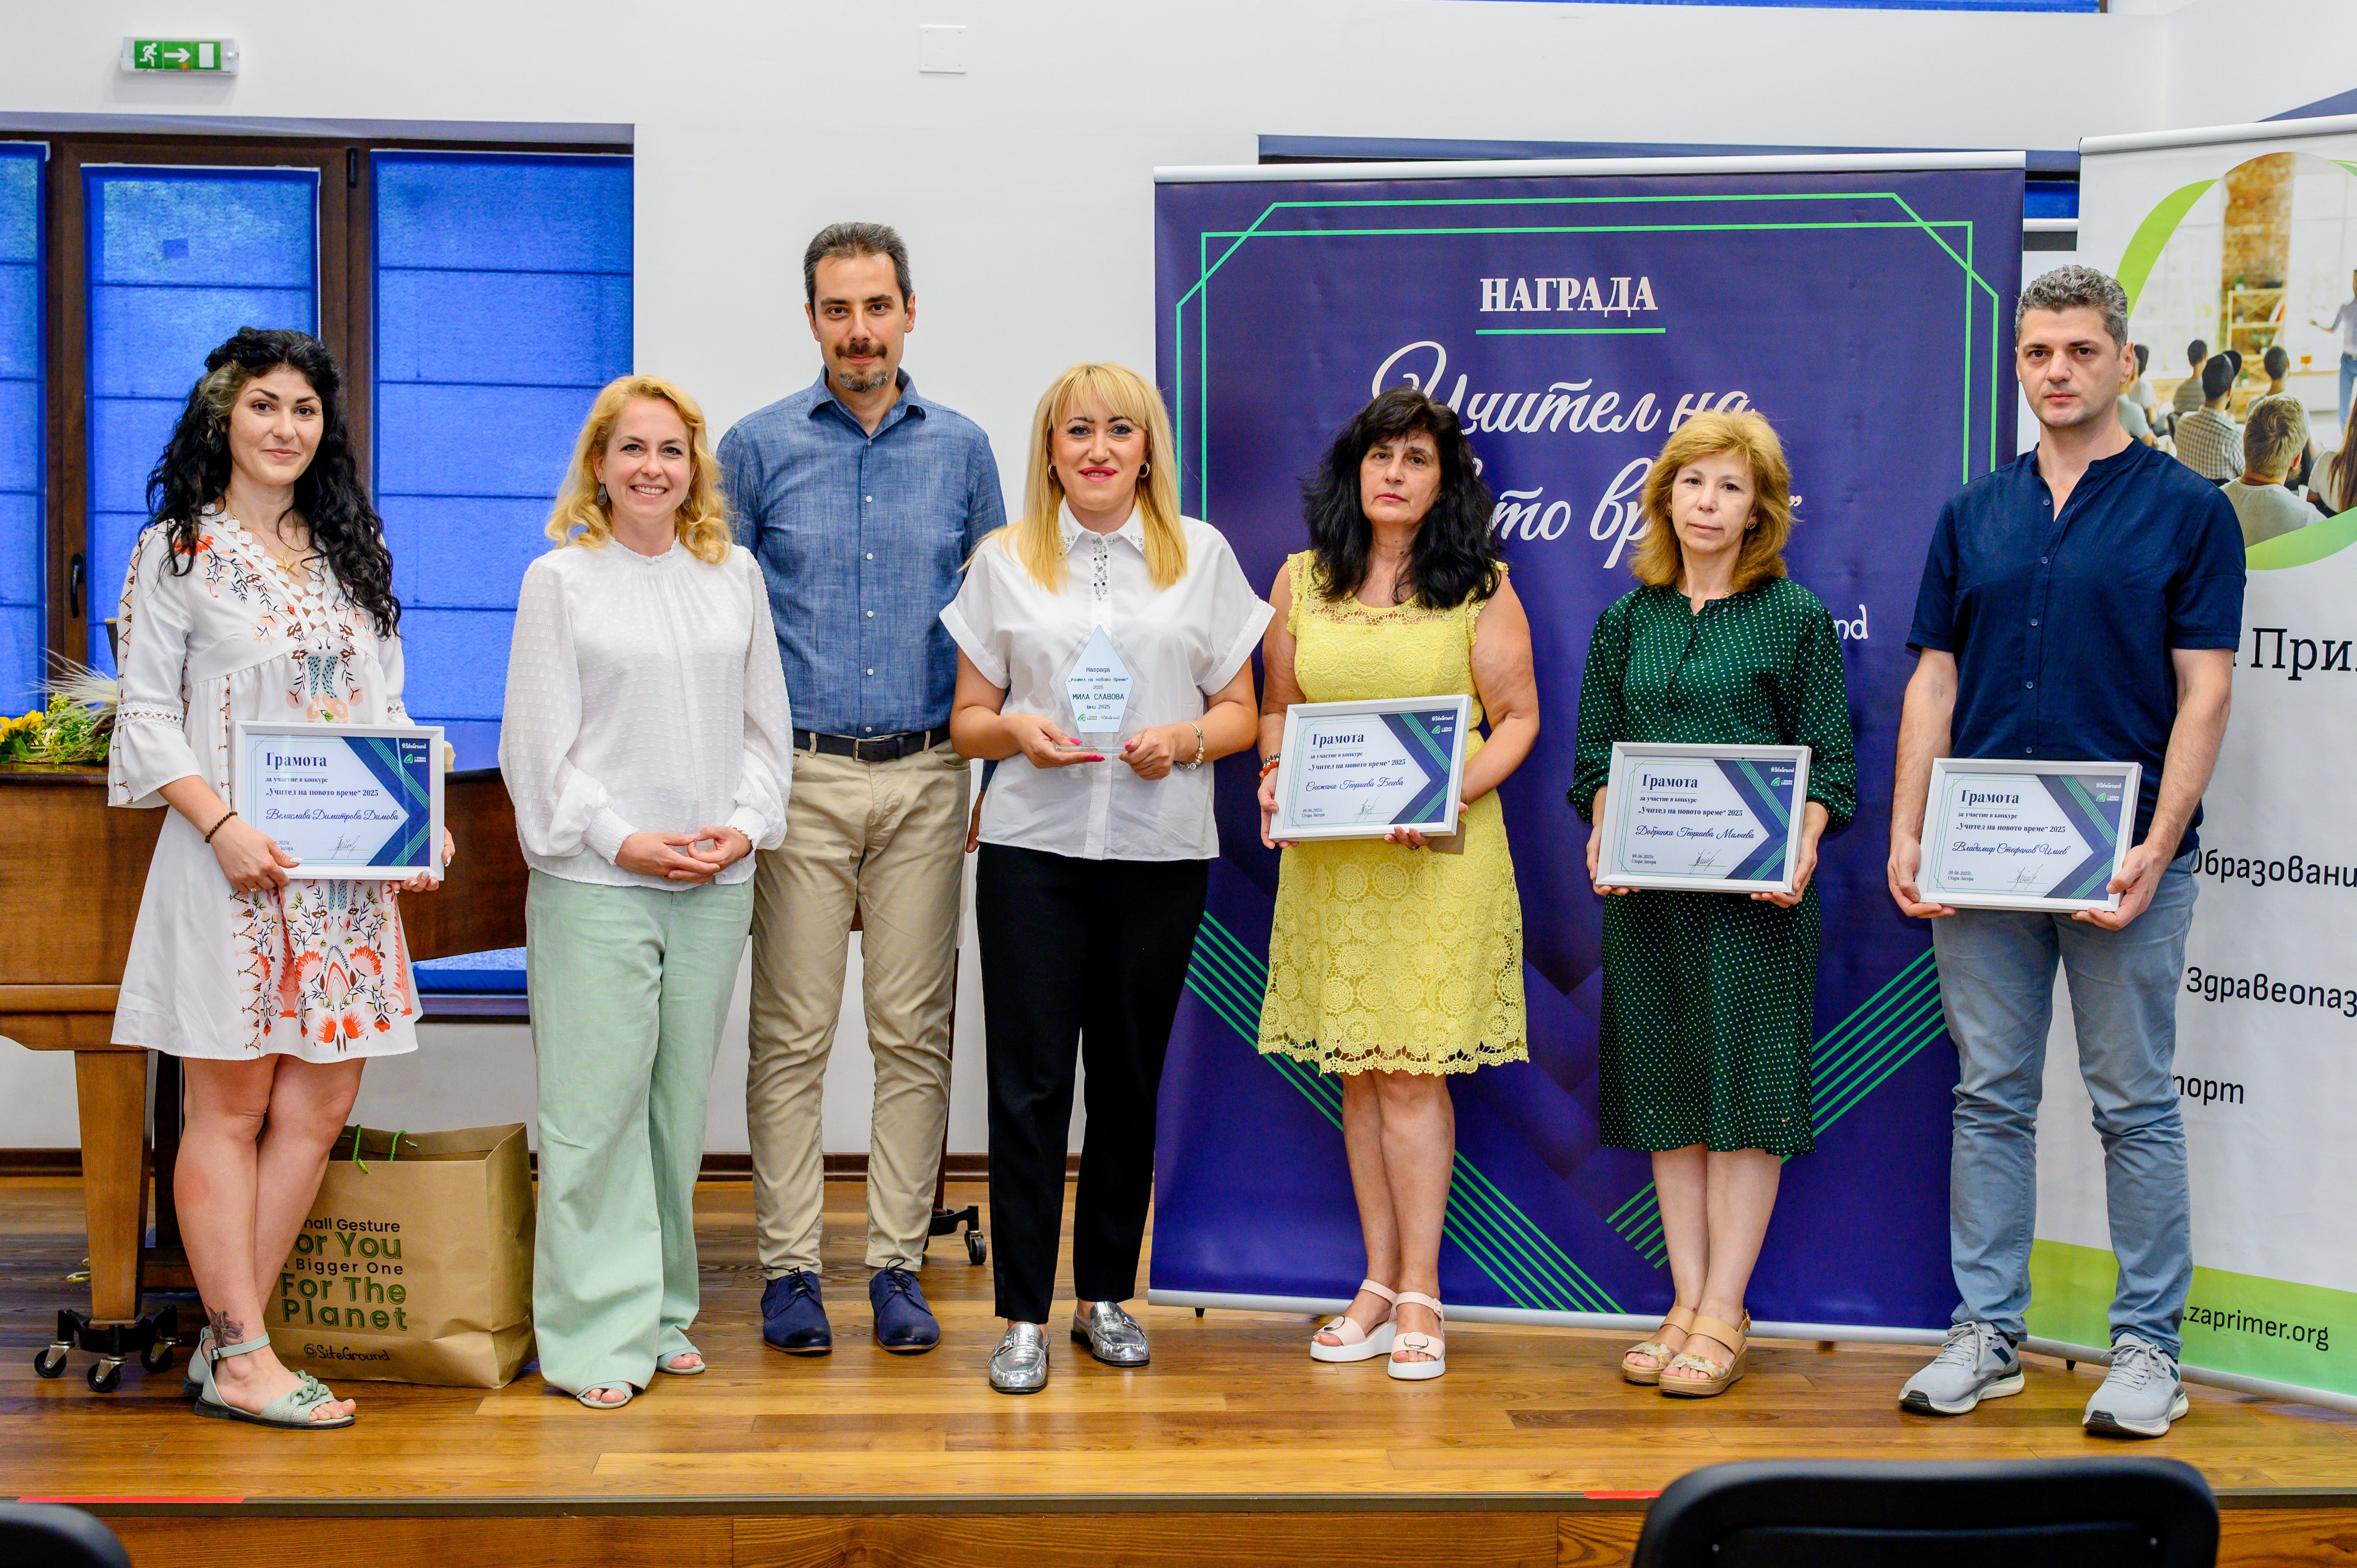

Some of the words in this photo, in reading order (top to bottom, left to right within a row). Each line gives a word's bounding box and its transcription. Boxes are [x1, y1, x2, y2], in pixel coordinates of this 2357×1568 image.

[1480, 276, 1658, 317] НАГРАДА
[2251, 628, 2357, 681] При
[1312, 733, 1364, 748] Грамота
[266, 752, 327, 770] Грамота
[1308, 763, 1334, 771] „Учител
[1369, 760, 1390, 769] време”
[1306, 781, 1337, 792] Снежана
[1339, 778, 1375, 792] Георгиева
[1378, 777, 1404, 787] Богева
[1642, 774, 1698, 791] Грамота
[266, 788, 296, 797] „Учител
[336, 789, 361, 798] време”
[1960, 790, 2019, 806] Грамота
[266, 808, 311, 820] Велислава
[312, 809, 362, 823] Димитрова
[363, 810, 399, 821] Димова
[1638, 806, 1666, 815] „Учител
[1703, 809, 1726, 818] време”
[1635, 825, 1673, 838] Добринка
[1676, 827, 1714, 838] Георгиева
[1716, 829, 1755, 839] Малчева
[1956, 823, 1985, 831] „Учител
[2024, 826, 2049, 834] време”
[1952, 841, 1996, 855] Владимир
[1997, 842, 2038, 856] Стефанов
[2186, 967, 2357, 1018] Здравеопаз
[2173, 1075, 2244, 1106] порт
[336, 1219, 400, 1233] Gesture
[294, 1233, 328, 1256] or
[334, 1231, 402, 1260] You
[296, 1257, 358, 1275] Bigger
[366, 1262, 404, 1275] One
[280, 1272, 333, 1300] For
[343, 1276, 407, 1305] The
[282, 1299, 408, 1331] Planet
[2184, 1306, 2329, 1351] .zaprimer.org
[318, 1345, 391, 1361] SiteGround
